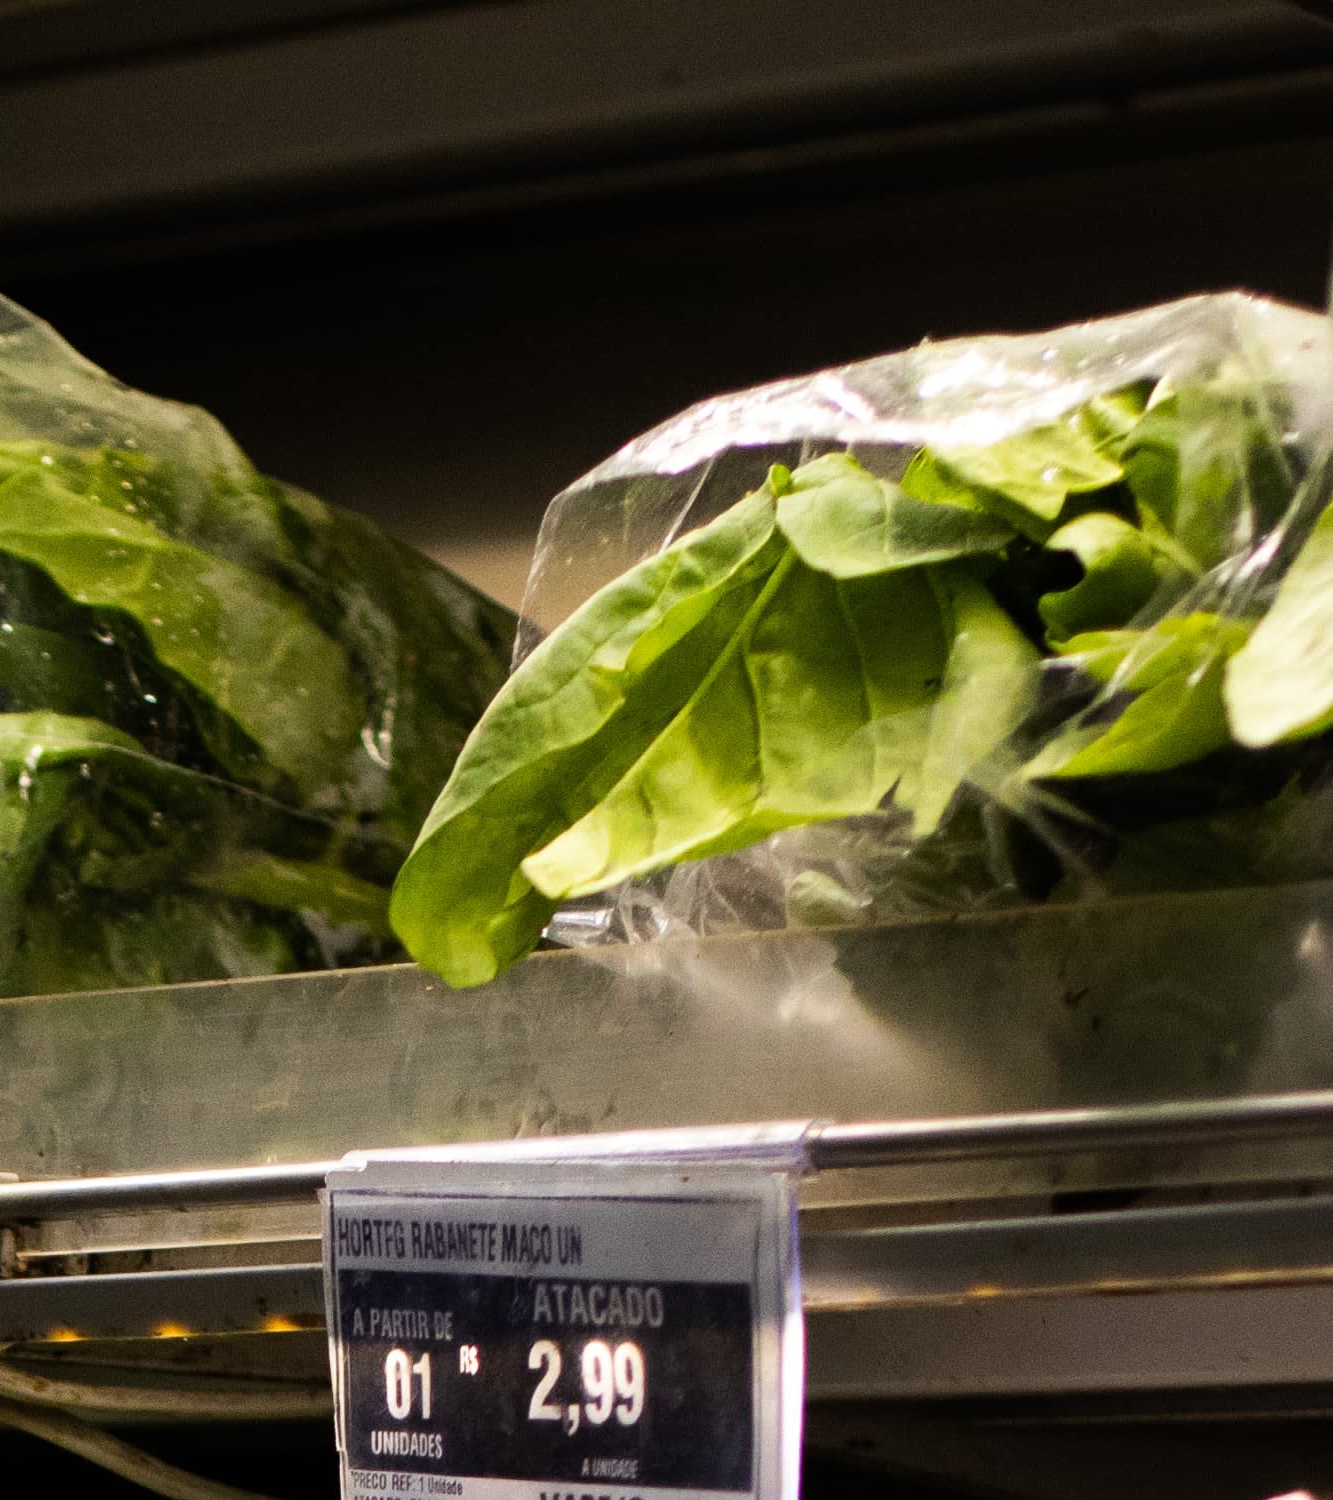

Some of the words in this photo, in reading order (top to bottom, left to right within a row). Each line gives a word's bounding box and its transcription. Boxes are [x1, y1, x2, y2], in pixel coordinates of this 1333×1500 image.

[338, 1218, 406, 1259] HORTFG
[411, 1221, 496, 1262] RABANETE
[557, 1226, 581, 1266] UN
[352, 1308, 364, 1335] A
[370, 1308, 430, 1339] PARTIR
[434, 1310, 453, 1341] DE
[534, 1283, 664, 1328] ATACADO
[385, 1349, 431, 1419] 01
[459, 1345, 479, 1376] R$
[528, 1340, 646, 1436] 2,99
[371, 1431, 443, 1459] UNIDADES
[592, 1458, 639, 1479] UNIDADE
